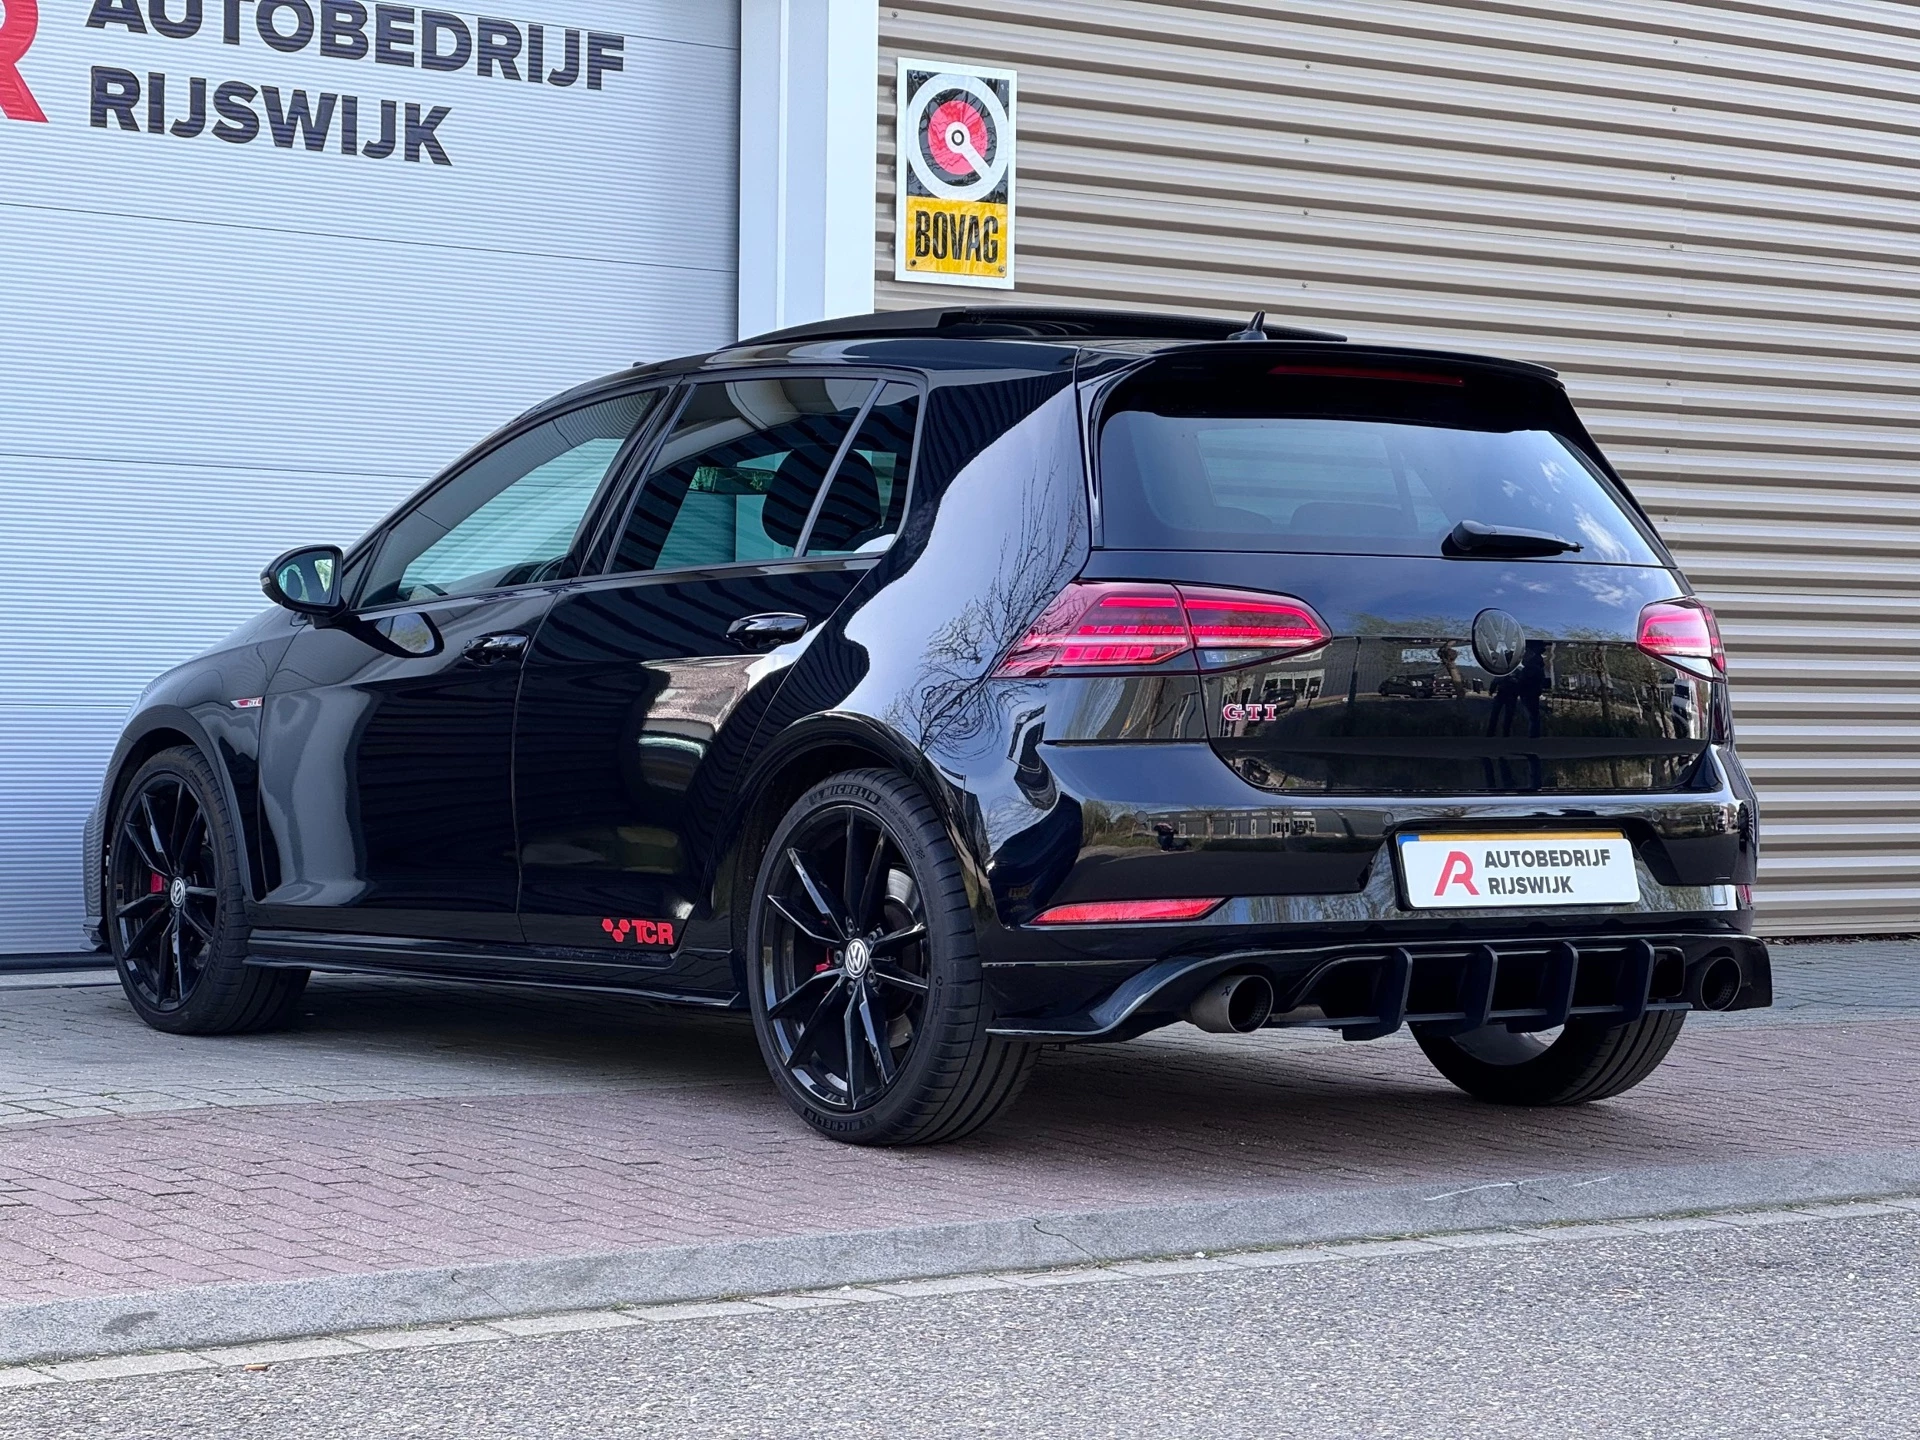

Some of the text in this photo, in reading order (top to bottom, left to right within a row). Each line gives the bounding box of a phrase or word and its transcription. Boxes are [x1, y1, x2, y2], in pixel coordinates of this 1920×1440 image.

[85, 0, 625, 91] AUTOBEDRIJF
[90, 65, 453, 166] RIJSWIJK
[915, 210, 999, 264] BOVAG
[1223, 703, 1277, 721] GTI
[823, 785, 878, 802] MICHELIN
[1484, 849, 1611, 868] AUTOBEDRIJF
[1487, 876, 1574, 895] RIJSWIJK
[631, 919, 674, 945] TCR
[805, 1108, 861, 1132] MICHELIN
